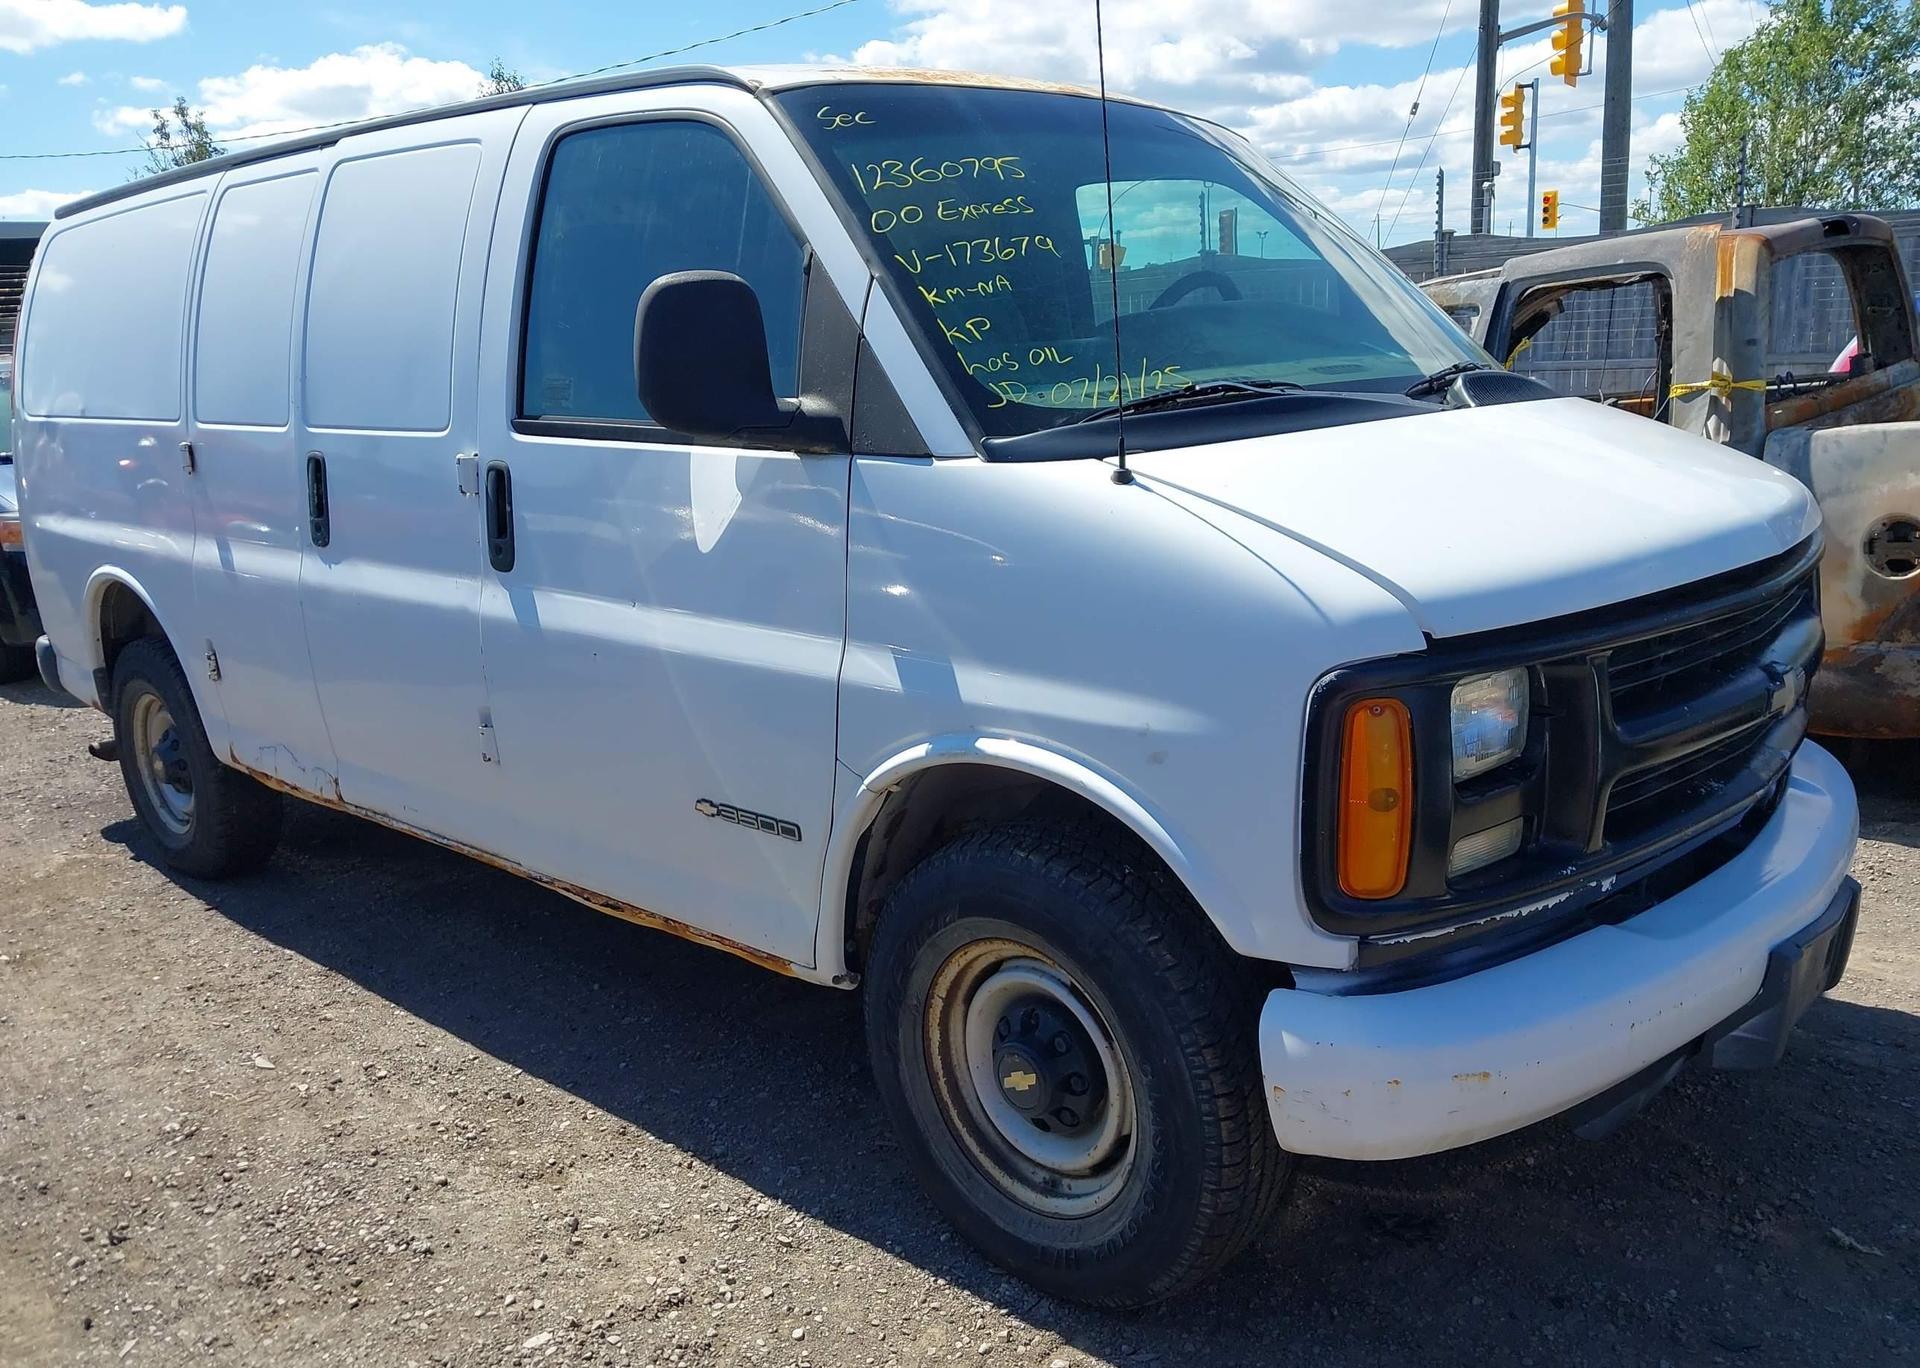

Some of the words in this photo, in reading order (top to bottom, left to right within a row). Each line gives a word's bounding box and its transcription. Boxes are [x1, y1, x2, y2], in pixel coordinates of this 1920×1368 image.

[816, 105, 877, 130] Sec
[851, 156, 1026, 195] 12360795
[936, 195, 1035, 222] Express
[956, 351, 1020, 376] has
[717, 803, 802, 842] 3500
